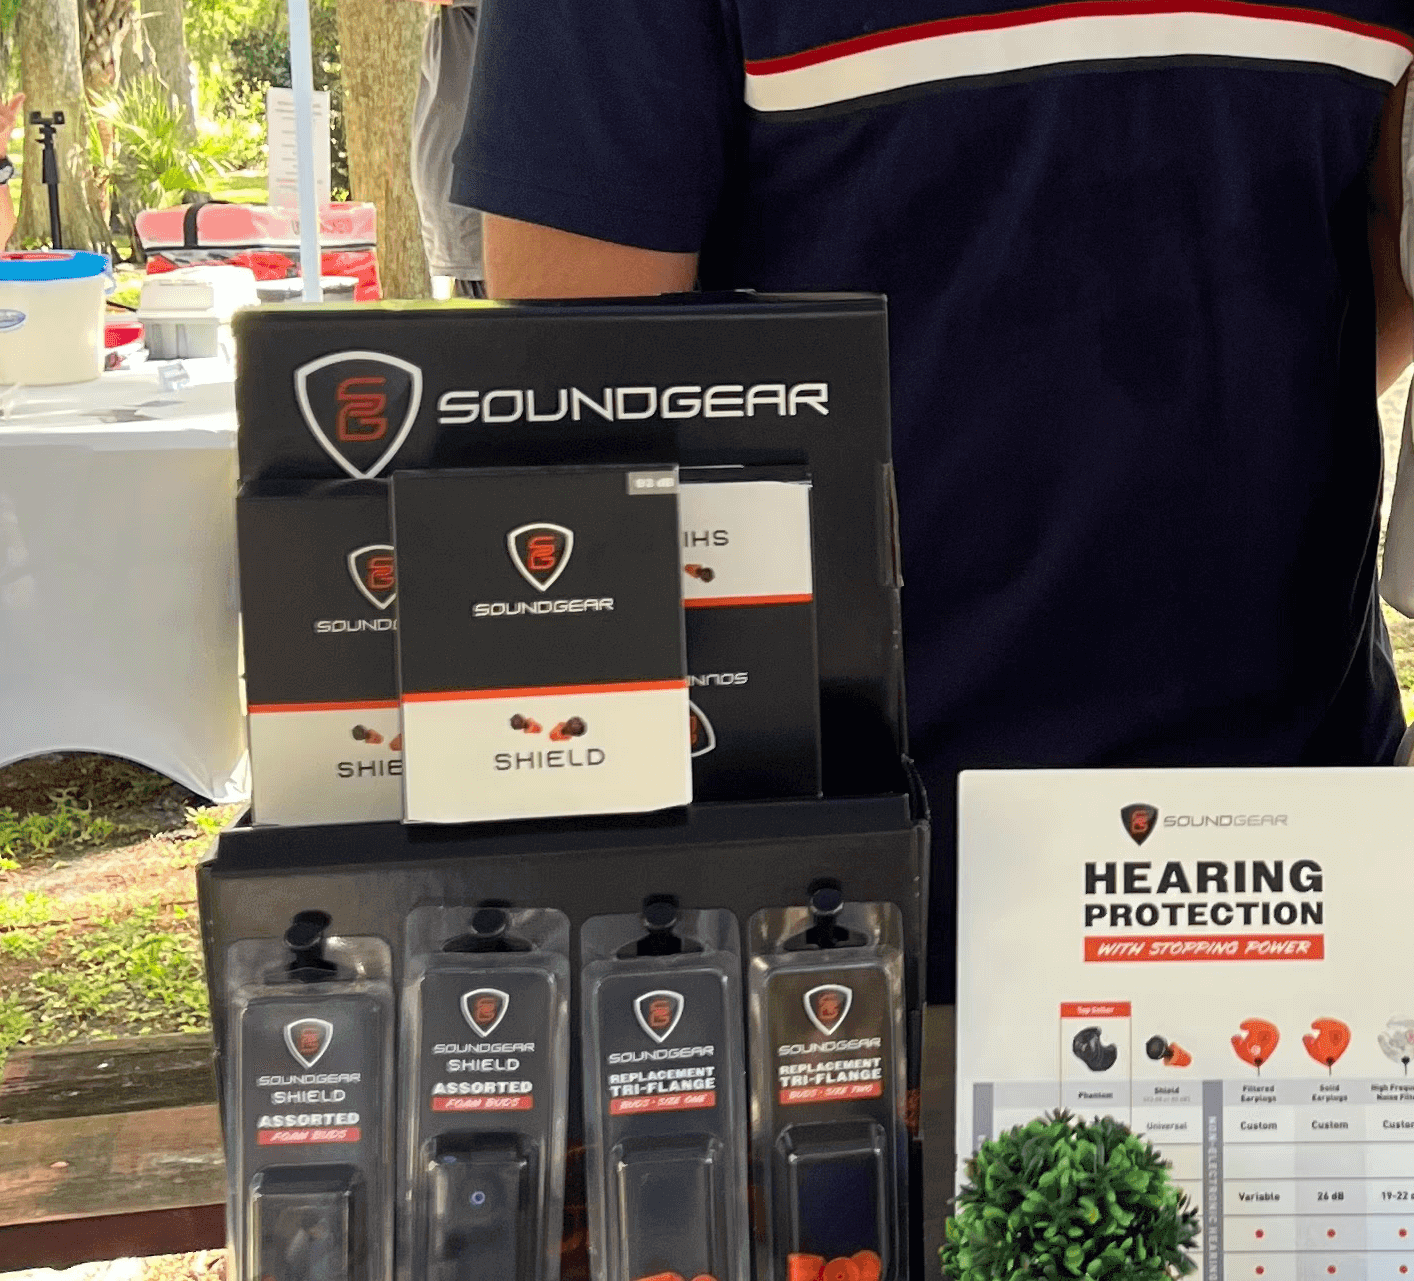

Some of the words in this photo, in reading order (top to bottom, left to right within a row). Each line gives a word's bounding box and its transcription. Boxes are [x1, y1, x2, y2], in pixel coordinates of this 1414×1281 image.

[438, 382, 828, 424] SOUNDGEAR
[473, 598, 614, 618] SOUNDGEAR
[494, 748, 606, 772] SHIELD
[1164, 814, 1288, 827] SOUNDGEAR
[1085, 859, 1324, 895] HEARING
[1085, 901, 1324, 927] PROTECTION
[1097, 942, 1143, 956] WITH
[1149, 940, 1239, 956] STOPPING
[1244, 939, 1311, 955] POWER
[432, 1042, 535, 1054] SOUNDGEAR
[609, 1045, 714, 1064] SOUNDGEAR
[778, 1038, 881, 1056] SOUNDGEAR
[446, 1058, 520, 1072] SHIELD
[779, 1058, 882, 1076] REPLACEMENT
[257, 1072, 361, 1085] SOUNDGEAR
[609, 1067, 715, 1085] REPLACEMENT
[780, 1068, 882, 1088] TRI-FLANGE
[432, 1081, 533, 1095] ASSORTED
[609, 1077, 715, 1097] TRI-FLANGE
[271, 1090, 346, 1104] SHIELD
[257, 1113, 360, 1128] ASSORTED
[1146, 1122, 1187, 1130] Universal
[1240, 1121, 1277, 1130] Custom
[1311, 1121, 1348, 1130] Custom
[1239, 1192, 1280, 1201] Variable
[1317, 1192, 1329, 1201] 26
